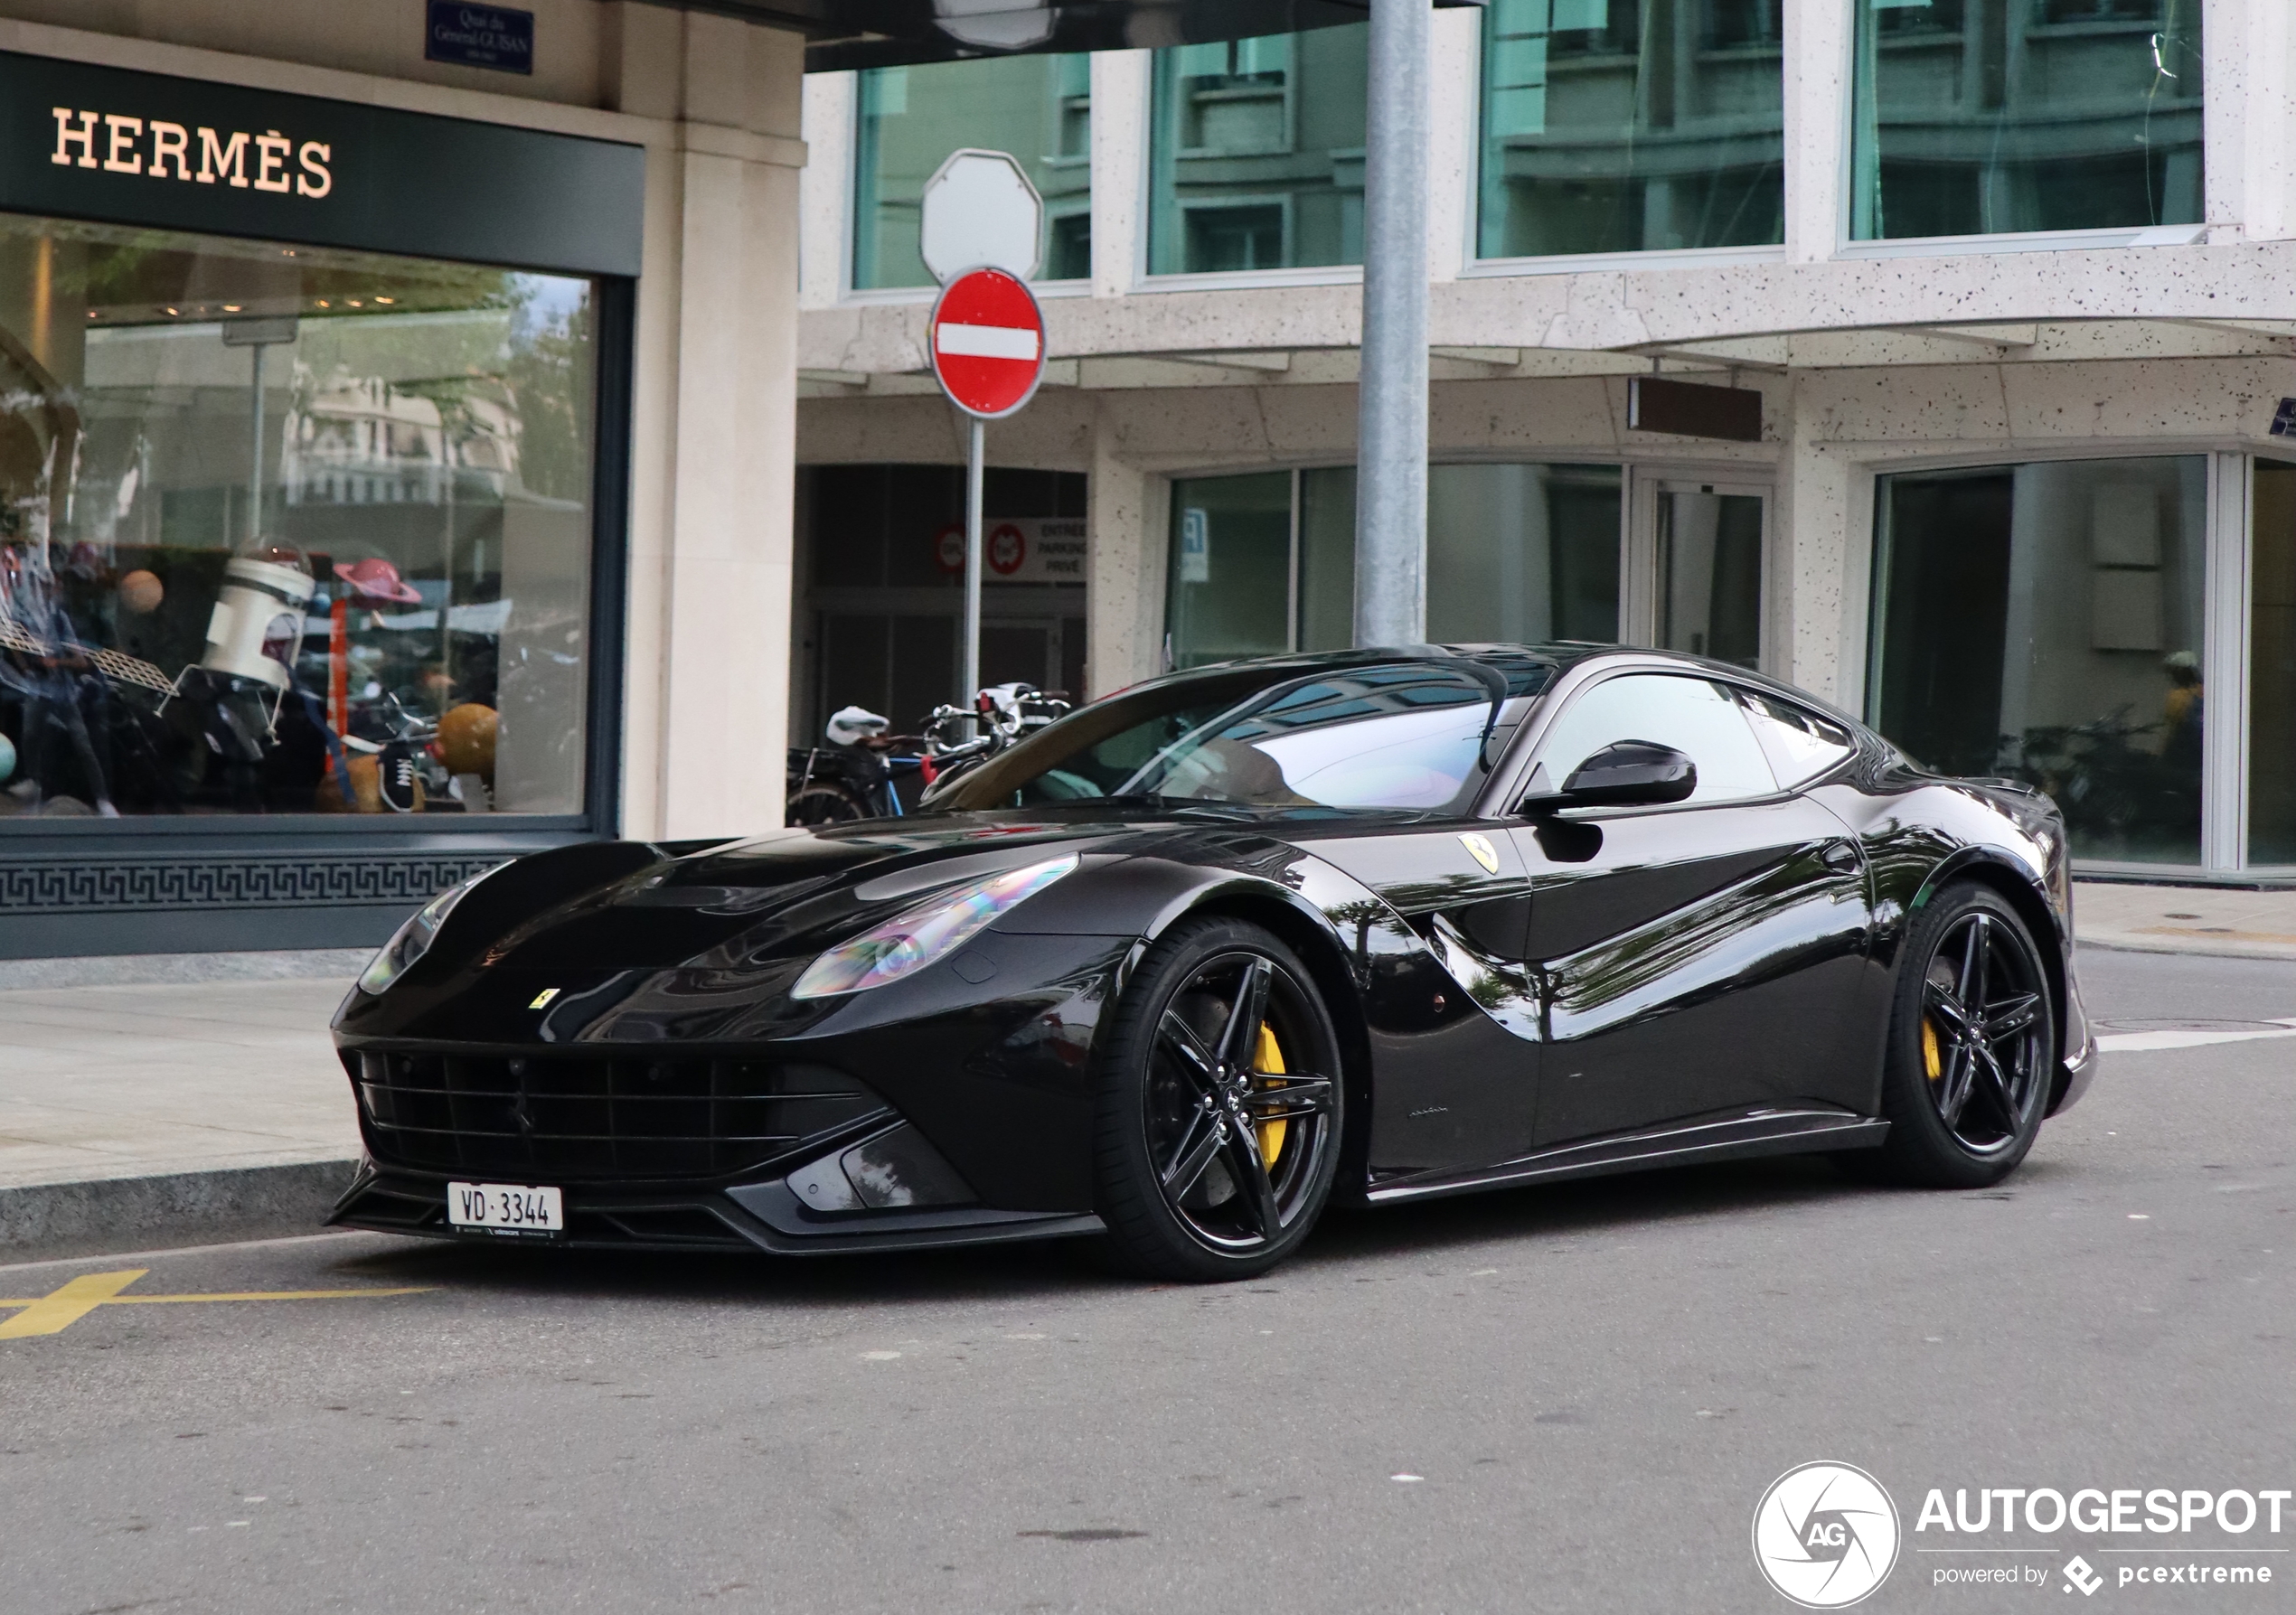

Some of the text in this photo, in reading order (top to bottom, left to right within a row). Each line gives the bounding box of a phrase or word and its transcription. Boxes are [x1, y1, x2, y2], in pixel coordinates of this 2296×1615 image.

[459, 8, 504, 31] Quai du
[52, 107, 332, 199] HERMÈS
[461, 1189, 549, 1225] VD 3344
